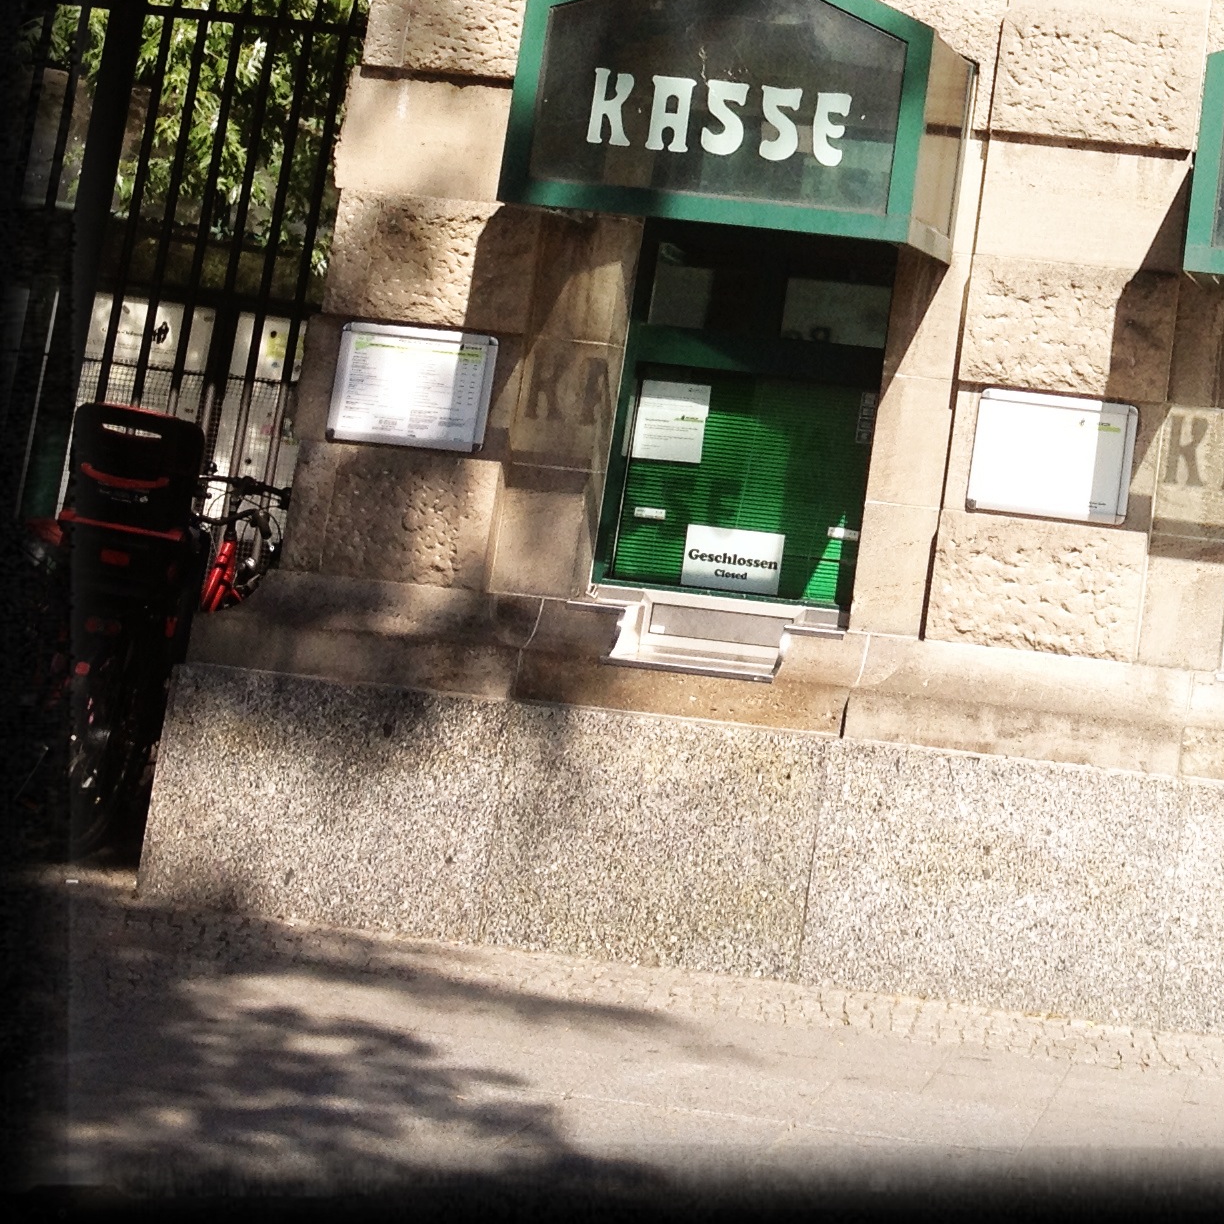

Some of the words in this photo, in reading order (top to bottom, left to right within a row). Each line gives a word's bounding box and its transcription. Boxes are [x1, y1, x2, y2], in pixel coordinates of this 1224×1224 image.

[587, 67, 853, 166] KASSE
[688, 548, 778, 570] Geschlossen
[714, 568, 748, 580] Closed
